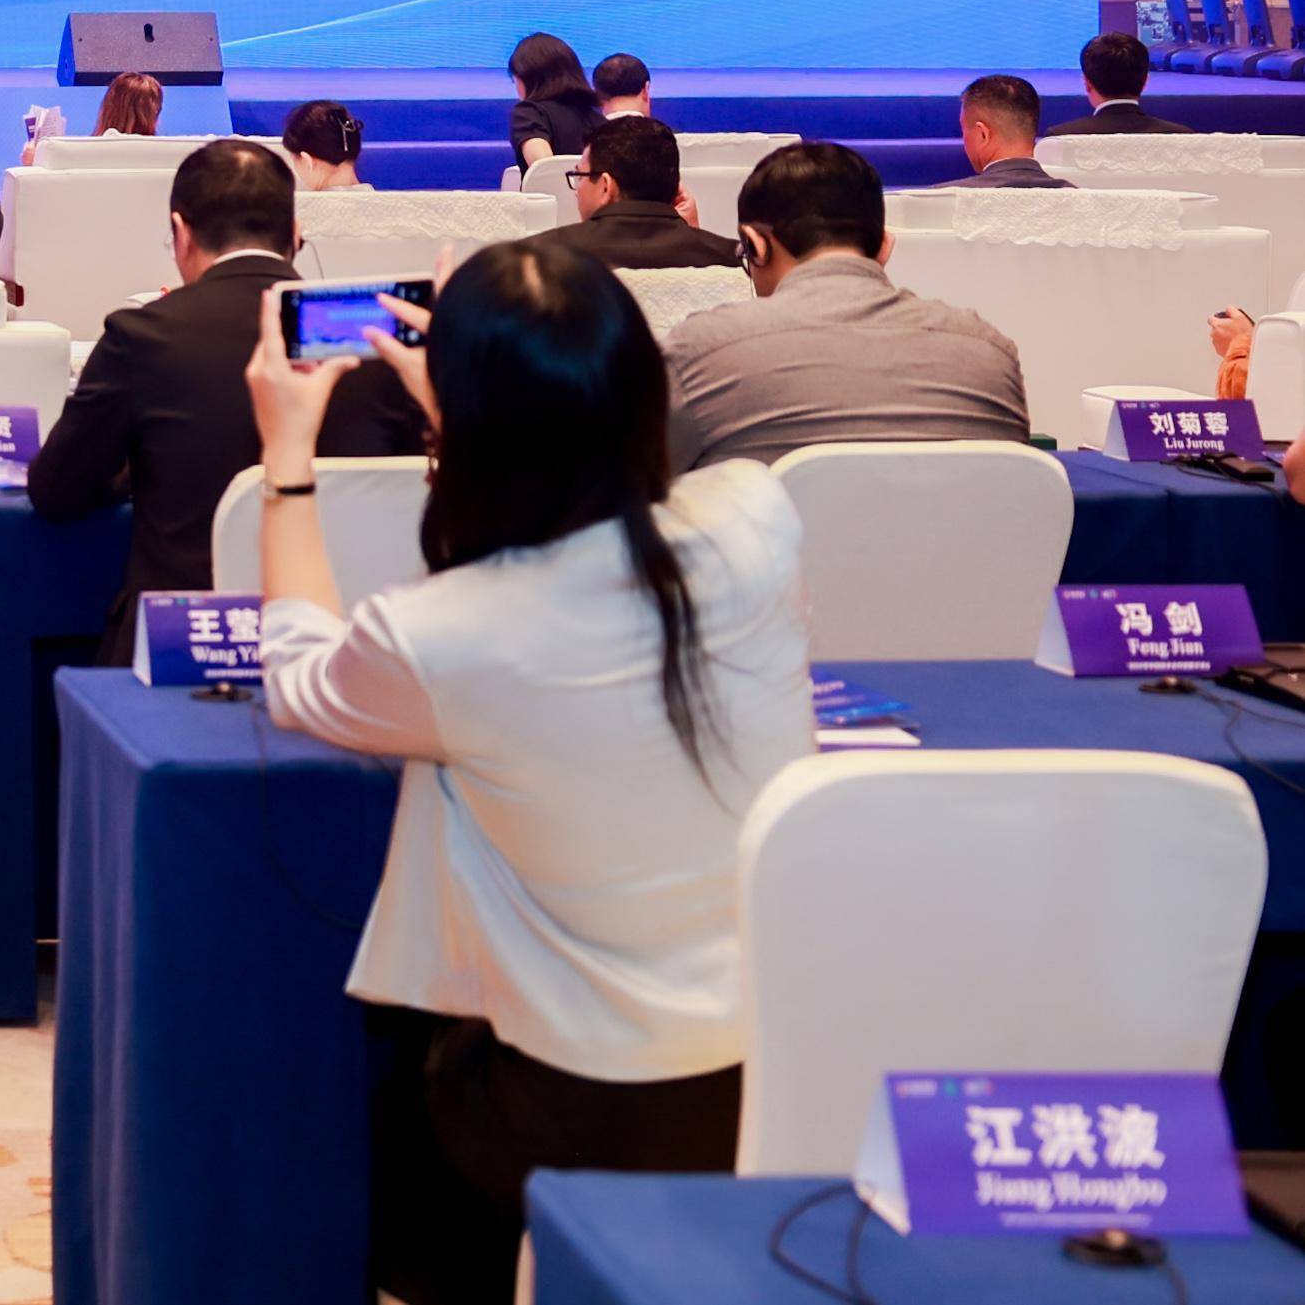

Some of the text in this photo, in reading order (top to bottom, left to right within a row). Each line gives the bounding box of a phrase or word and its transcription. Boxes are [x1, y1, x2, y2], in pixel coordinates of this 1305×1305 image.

[1148, 412, 1229, 436] 刘菊蓉
[1164, 437, 1184, 449] Liu
[1115, 601, 1203, 636] 冯剑
[191, 645, 237, 666] Wang
